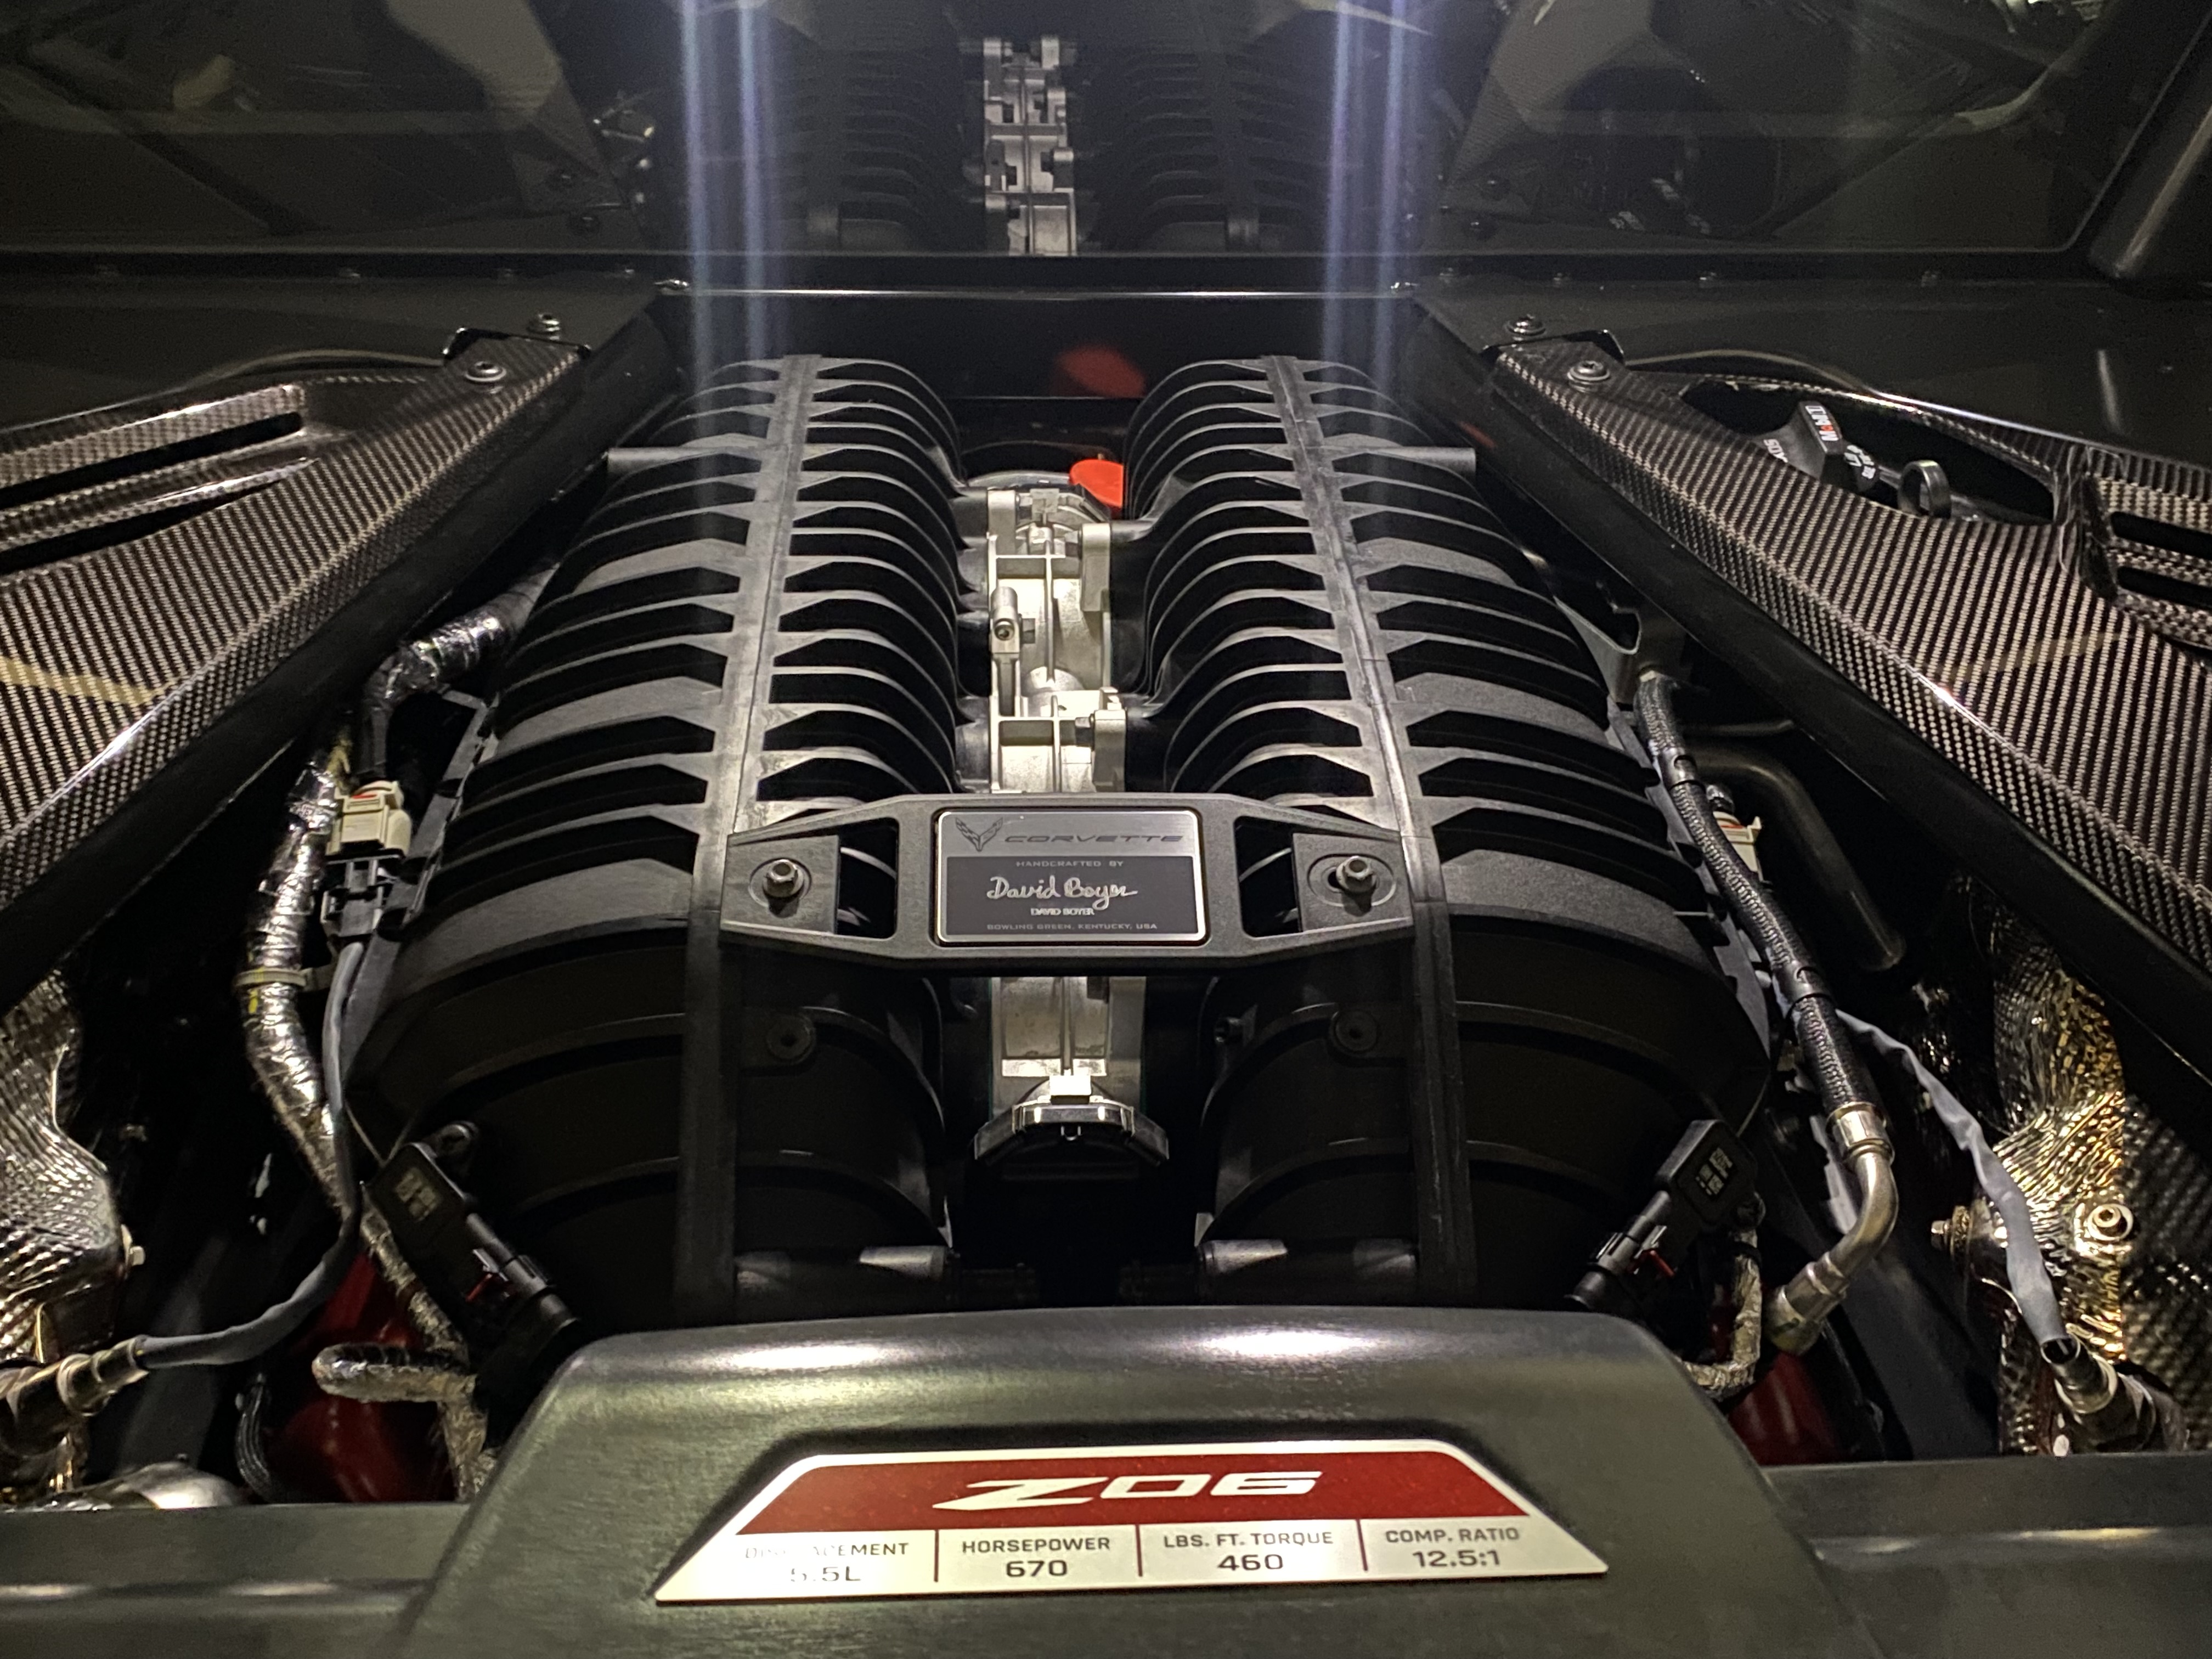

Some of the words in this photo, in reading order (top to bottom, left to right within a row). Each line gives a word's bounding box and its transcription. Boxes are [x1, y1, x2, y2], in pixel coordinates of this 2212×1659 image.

[1005, 835, 1183, 843] CORVETTE
[986, 875, 1062, 899] David
[1030, 907, 1062, 916] DAVID
[1062, 907, 1095, 916] BOYER
[932, 1471, 1323, 1511] Z06
[1163, 1534, 1210, 1548] LBS.
[1216, 1533, 1245, 1547] FT.
[1250, 1531, 1334, 1547] TORQUE
[1385, 1529, 1453, 1543] COMP.
[1458, 1527, 1520, 1543] RATIO
[962, 1537, 1110, 1554] HORSEPOWER
[1216, 1553, 1284, 1571] 460
[1412, 1549, 1501, 1568] 12.5:1
[1006, 1559, 1068, 1578] 670
